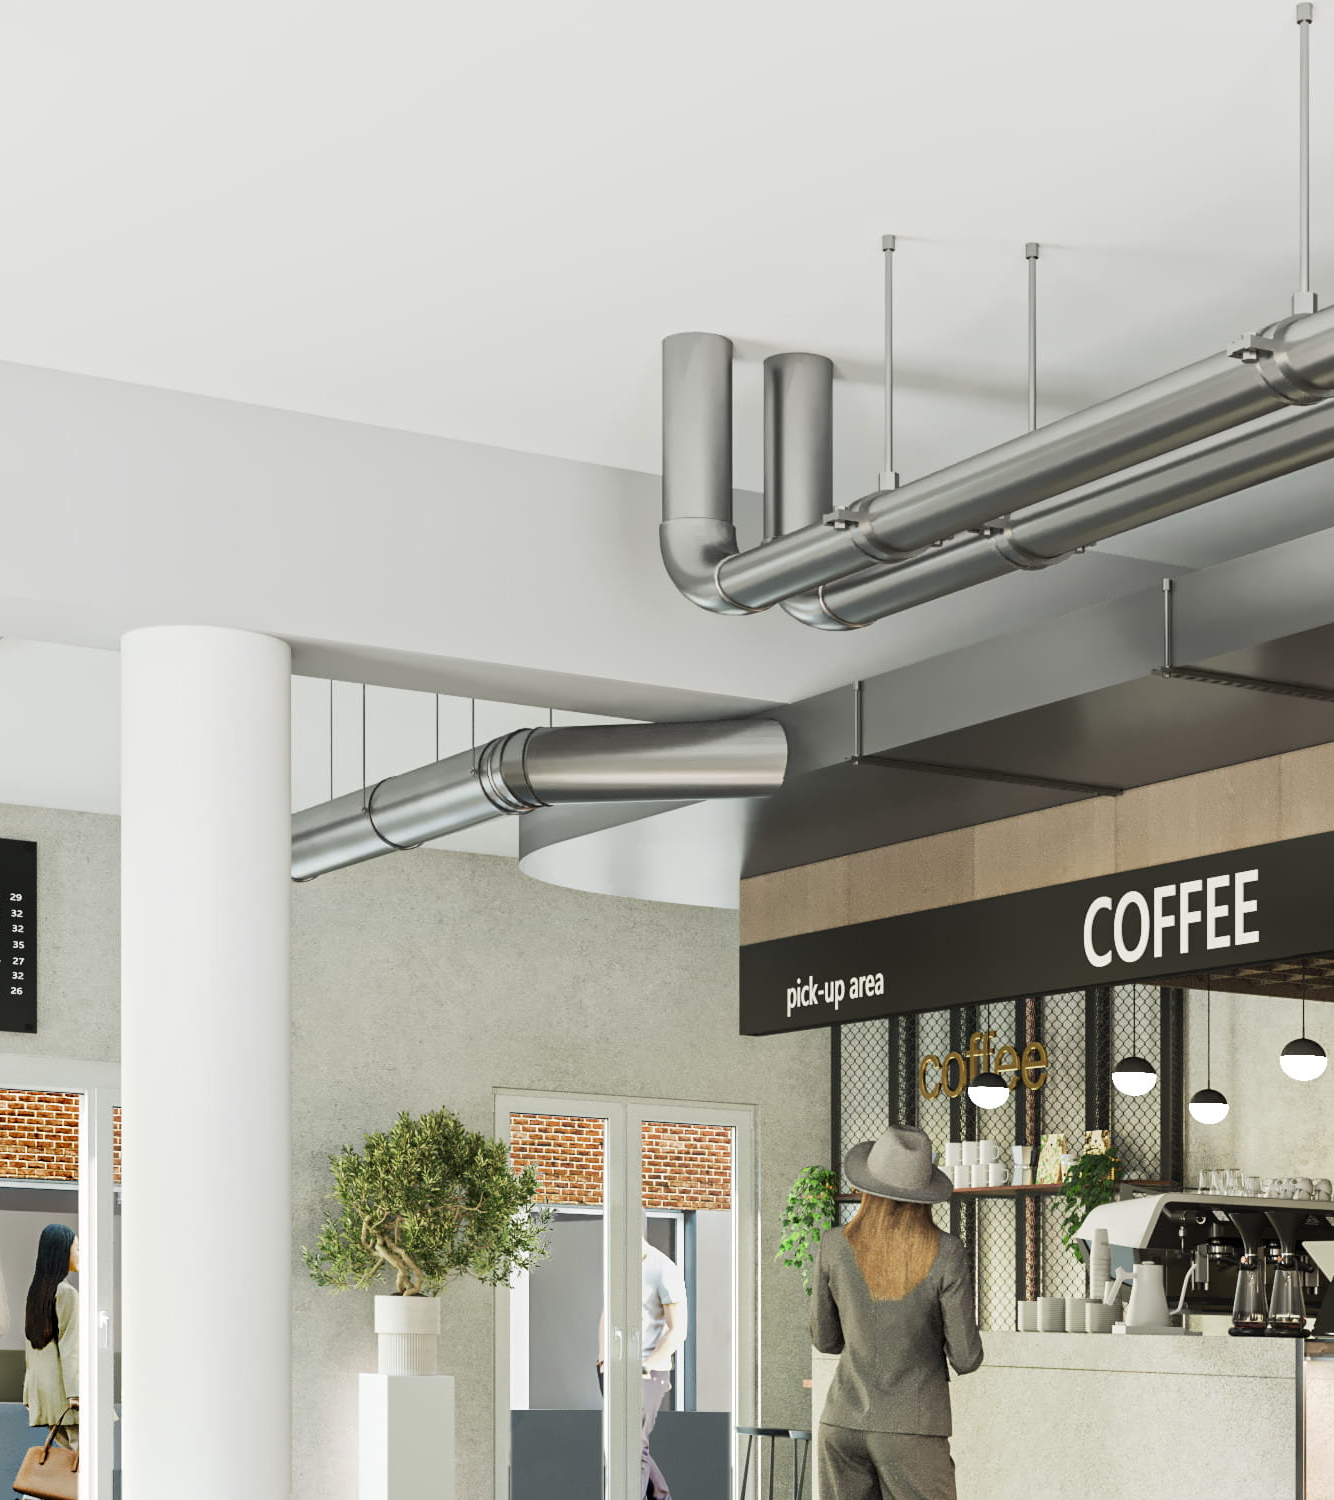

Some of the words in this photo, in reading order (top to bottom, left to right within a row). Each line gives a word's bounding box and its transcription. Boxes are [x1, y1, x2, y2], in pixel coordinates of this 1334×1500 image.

[10, 893, 22, 901] 29
[1083, 869, 1260, 968] COFFEE
[787, 976, 845, 1017] pick-up
[850, 972, 884, 1000] area
[919, 1030, 1048, 1100] coffee
